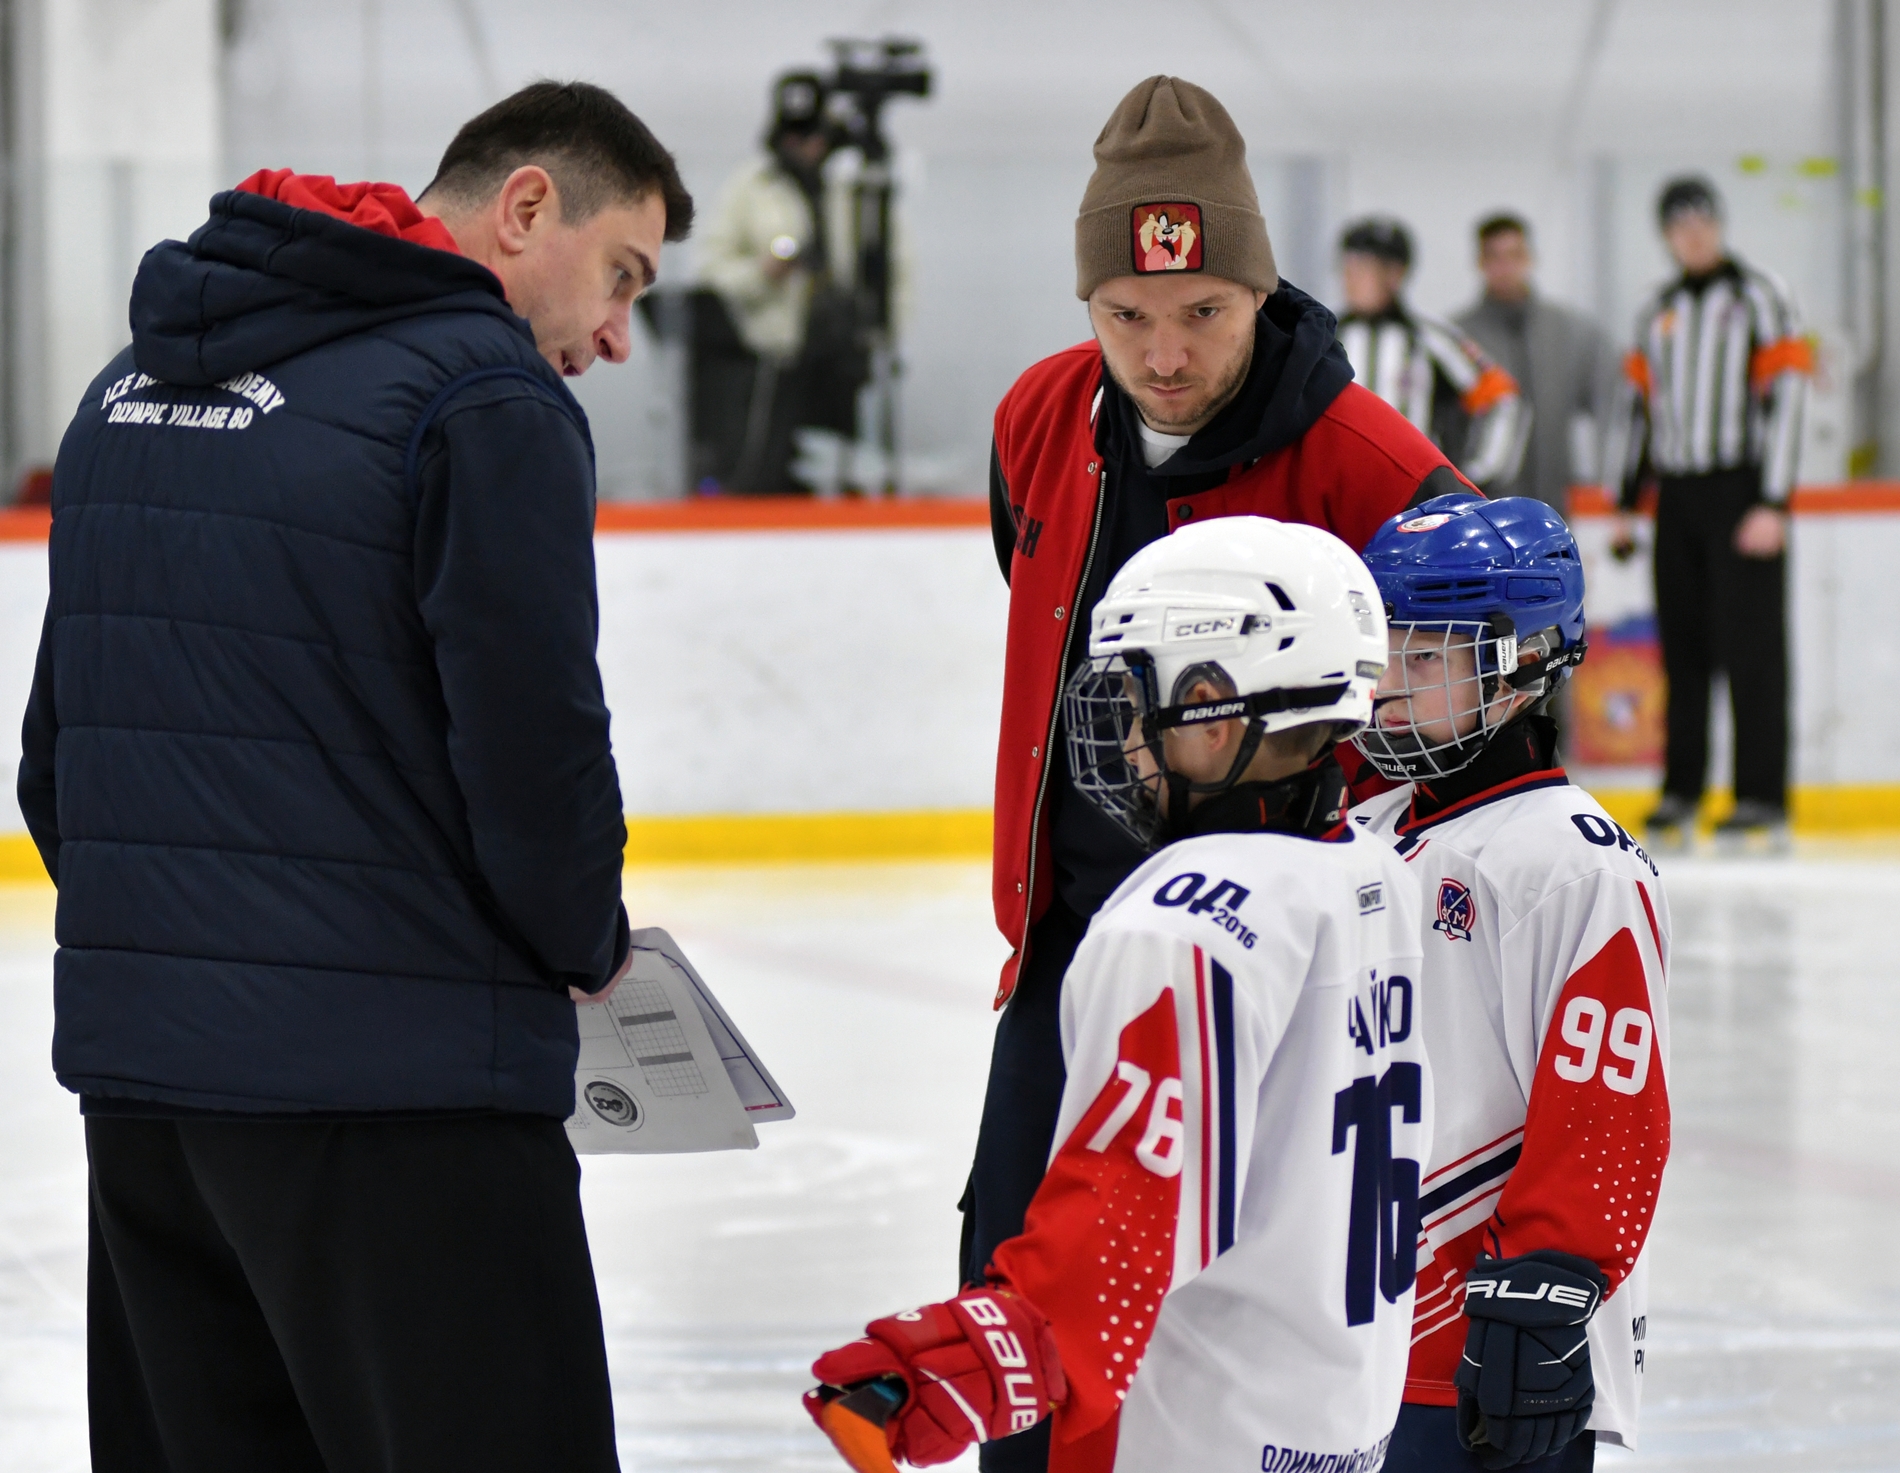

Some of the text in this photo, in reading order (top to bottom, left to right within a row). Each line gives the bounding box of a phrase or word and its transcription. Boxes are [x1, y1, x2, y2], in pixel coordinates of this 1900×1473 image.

[100, 372, 136, 410] ICE
[107, 401, 254, 430] OLYMPIC VILLAGE 80
[1176, 617, 1234, 637] CCM
[1181, 702, 1246, 722] BAUER
[1152, 872, 1251, 915] ОД
[1212, 908, 1259, 950] 2016
[1554, 996, 1652, 1095] 99
[1085, 1060, 1184, 1178] 76
[1331, 1061, 1422, 1328] 76
